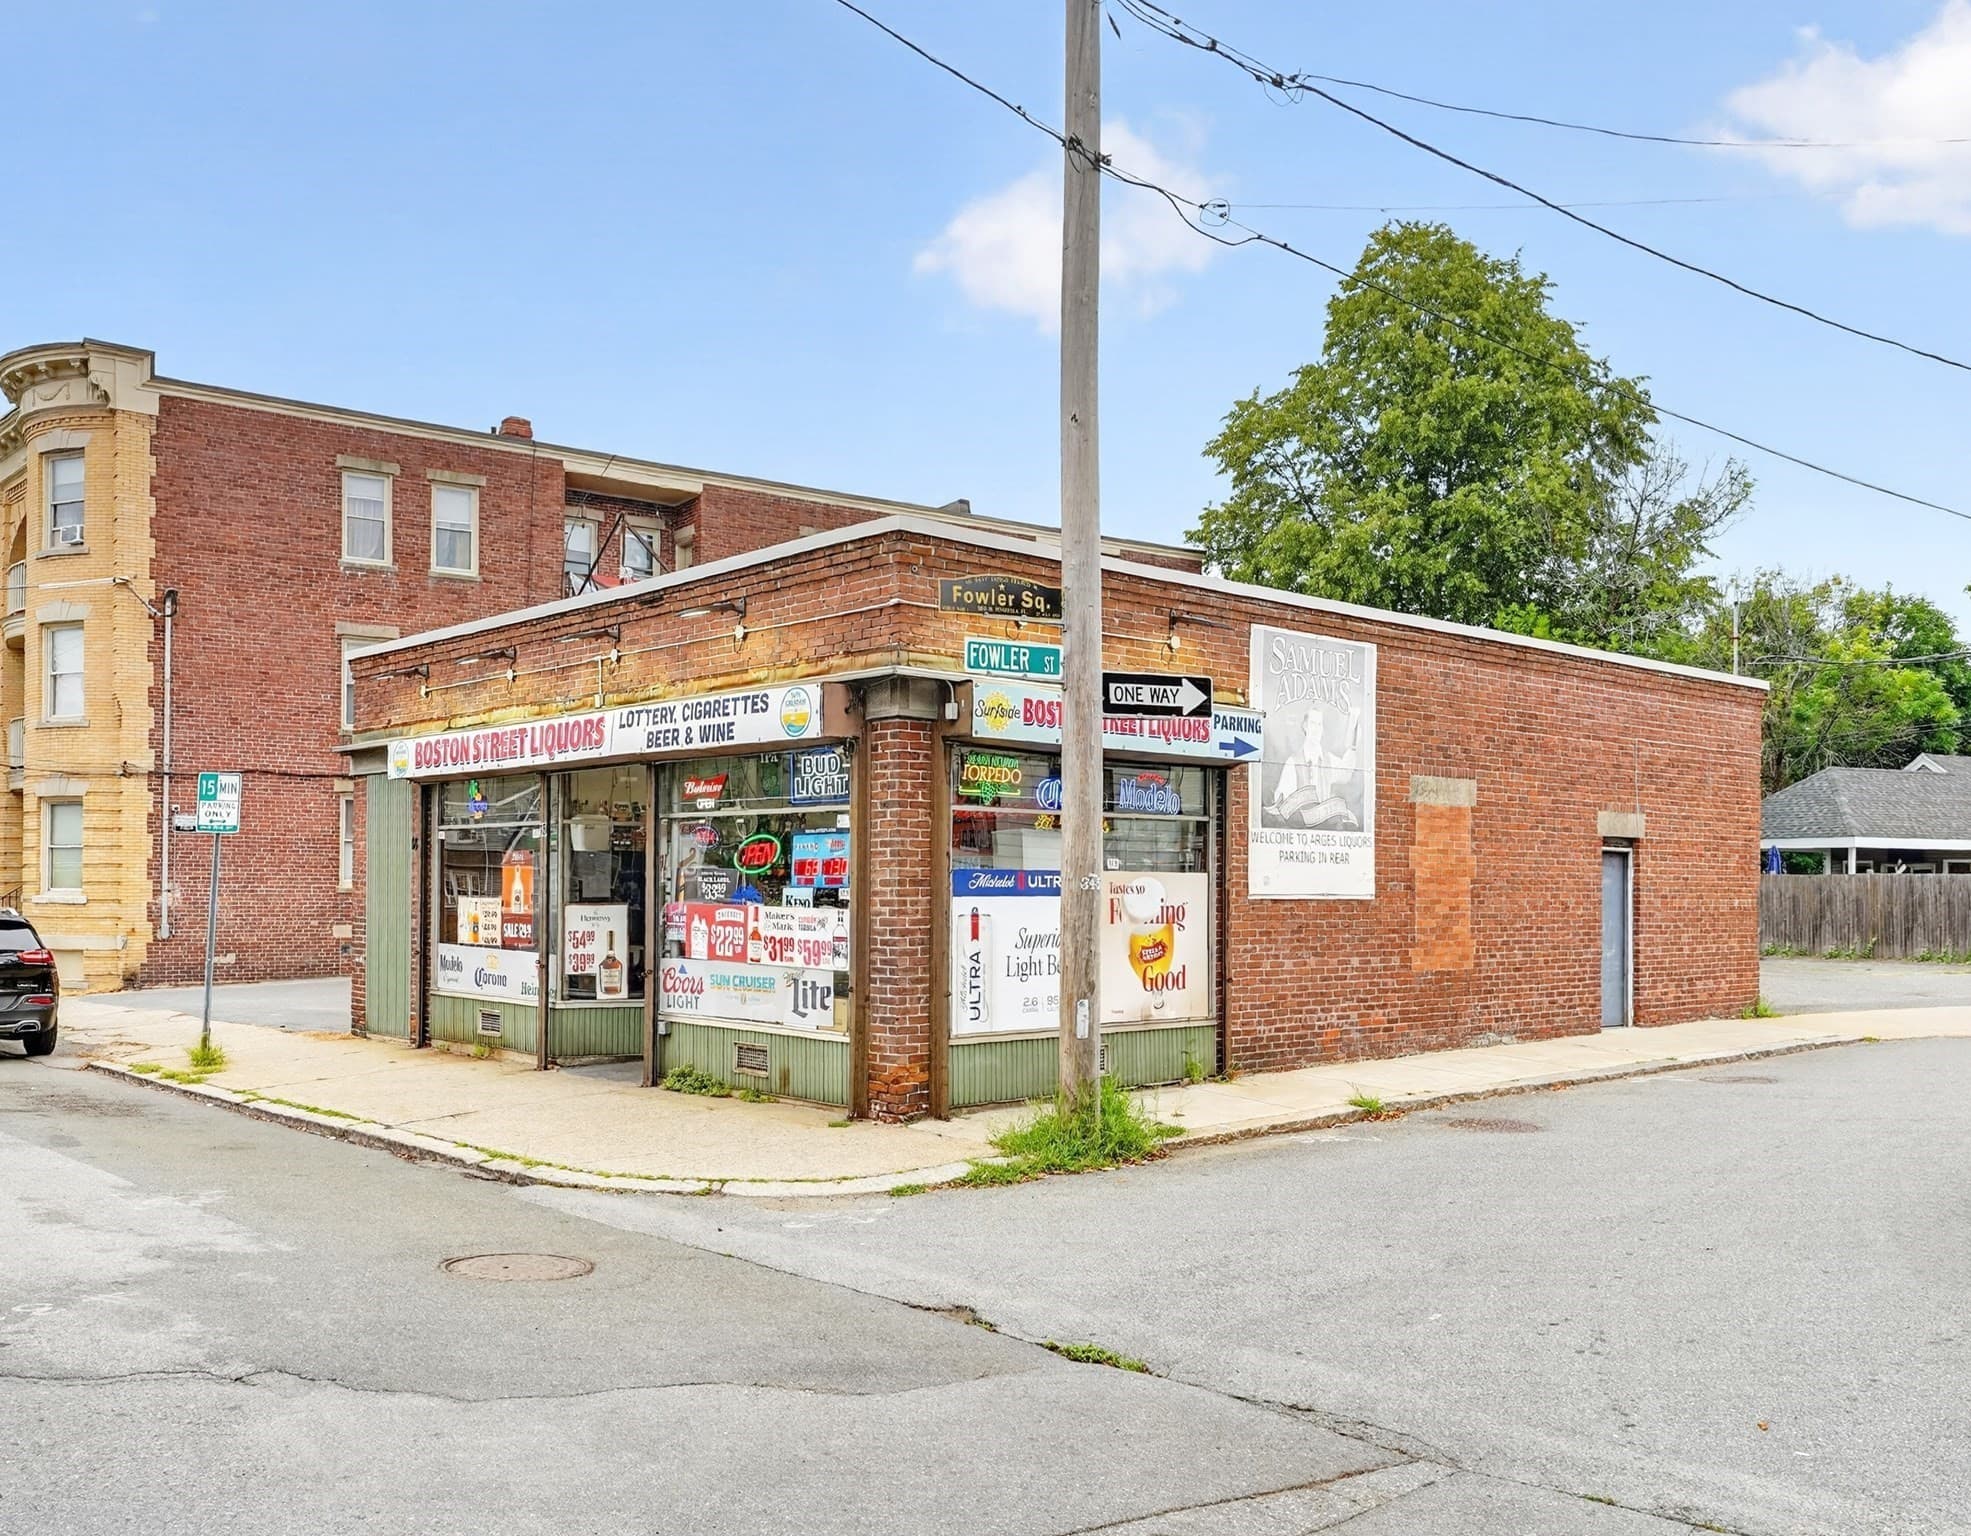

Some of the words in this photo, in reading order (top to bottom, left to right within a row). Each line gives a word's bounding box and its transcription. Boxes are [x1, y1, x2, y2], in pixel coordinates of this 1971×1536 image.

[952, 584, 1015, 607] Fowler
[1021, 590, 1051, 613] Sq.
[969, 643, 1030, 671] FOWLER
[1043, 656, 1055, 673] ST
[1269, 636, 1361, 681] SAMUEL
[1114, 686, 1144, 703] ONE
[1150, 688, 1180, 704] WAY
[1275, 673, 1352, 715] ADAMS
[619, 705, 678, 729] LOTTERY,
[682, 693, 770, 720] CIGARETTES
[974, 699, 1021, 720] Surfside
[1023, 697, 1063, 729] BOST
[1102, 717, 1145, 737] TREET
[1148, 717, 1211, 745] LIQUORS
[646, 728, 680, 749] BEER
[684, 727, 694, 746] &
[699, 721, 736, 745] WINE
[1213, 713, 1262, 734] PARKING
[414, 735, 471, 769] BOSTON
[472, 727, 528, 764] STREET
[530, 716, 606, 760] LIQUORS
[802, 754, 840, 776] BUD
[961, 764, 1022, 784] TORPEDO
[201, 780, 215, 796] 15
[220, 782, 237, 795] MIN
[795, 774, 846, 797] LIGHT
[1120, 778, 1181, 815] Modelo
[1252, 832, 1294, 845] WELCOME
[1296, 833, 1308, 846] TO
[1339, 836, 1373, 849] LIQUORS
[1279, 850, 1316, 864] PARKING
[1318, 852, 1327, 863] IN
[1329, 852, 1350, 864] REAR
[1027, 874, 1061, 888] ULTR
[1014, 927, 1061, 953] Superio
[474, 967, 507, 989] Corona
[663, 967, 704, 995] Coors
[1006, 955, 1043, 982] Light
[1047, 955, 1061, 976] Be
[1142, 965, 1186, 992] Good
[710, 974, 730, 986] SUN
[732, 975, 775, 990] CRUISER
[969, 951, 982, 1021] ULTRA
[666, 994, 700, 1010] LIGHT
[792, 978, 832, 1018] Lite
